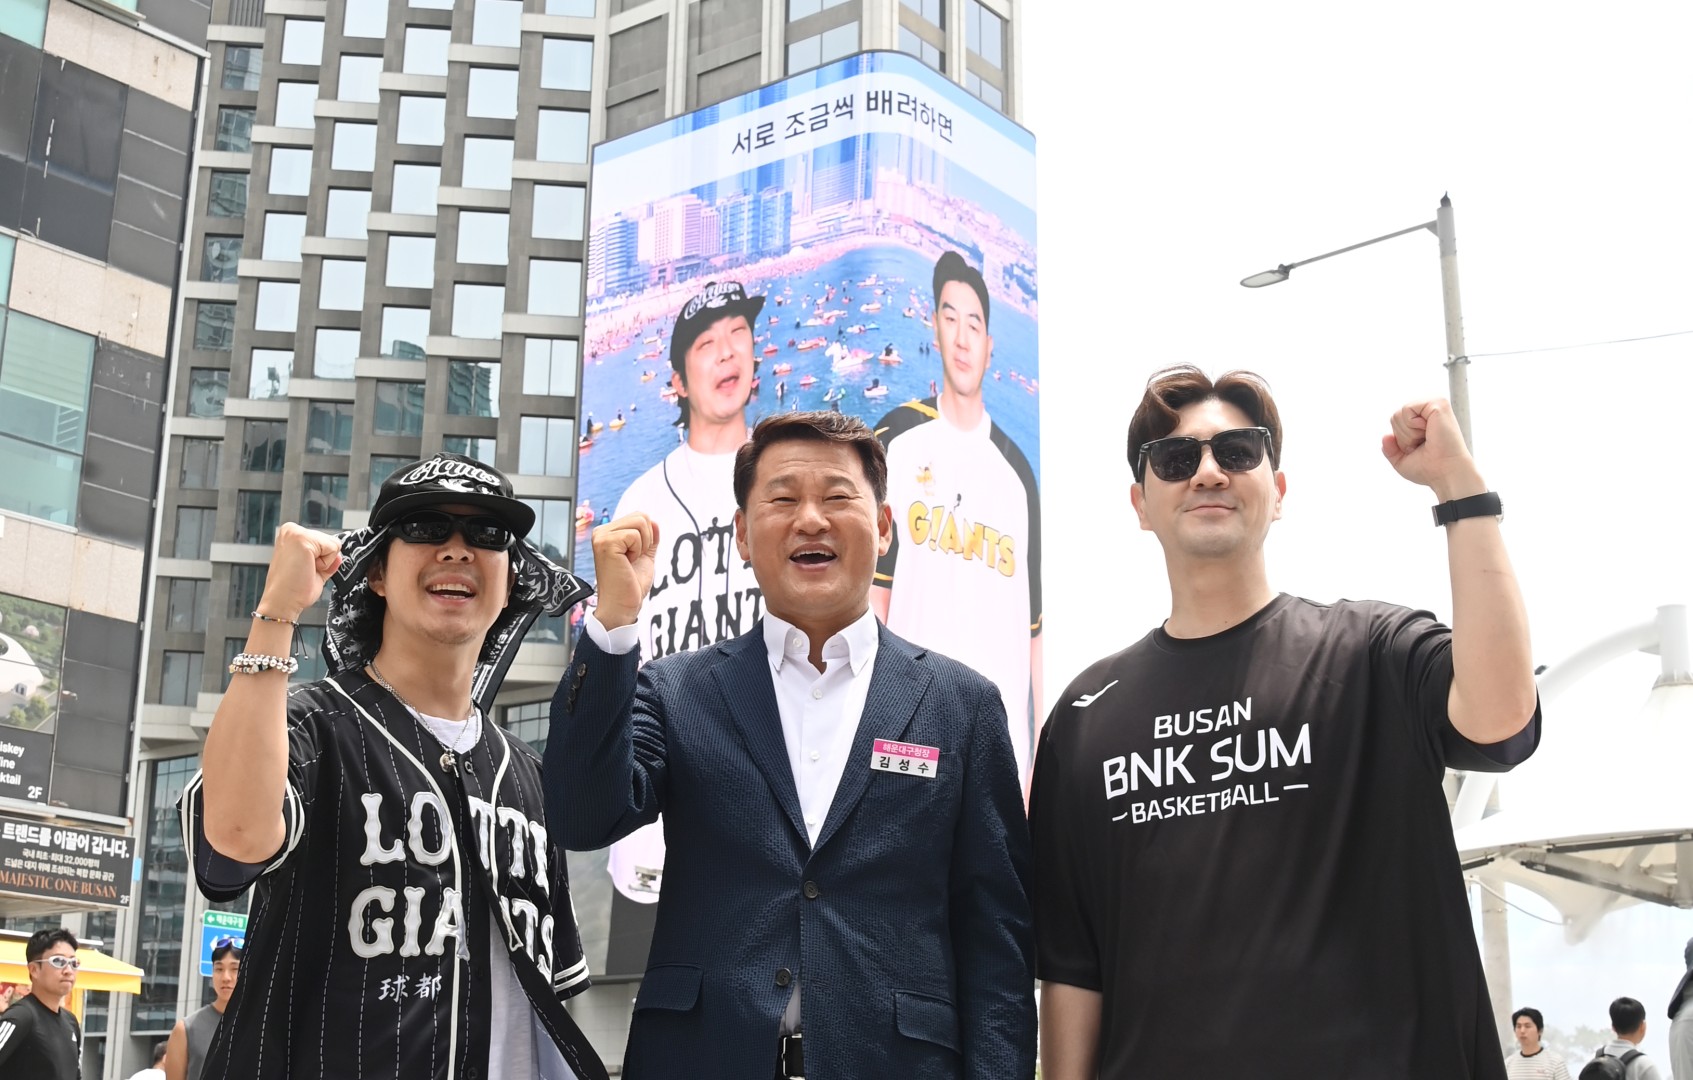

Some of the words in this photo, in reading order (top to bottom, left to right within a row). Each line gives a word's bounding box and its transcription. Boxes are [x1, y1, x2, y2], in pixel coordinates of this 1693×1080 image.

[731, 121, 775, 154] 서로
[784, 94, 854, 139] 조금씩
[866, 89, 953, 144] 배려하면
[651, 587, 764, 660] GIANT
[1154, 697, 1252, 739] BUSAN
[0, 741, 25, 757] iskey
[0, 756, 15, 769] ine
[882, 743, 930, 758] 해운대구청장
[1103, 744, 1196, 800] BNK
[1210, 723, 1311, 781] SUM
[0, 772, 21, 785] ktail
[28, 785, 43, 799] 2F
[1131, 782, 1279, 823] BASKETBALL
[22, 848, 36, 859] 국내
[54, 830, 90, 853] 이끌어
[92, 836, 130, 858] 갑니다.
[24, 860, 37, 871] 대지
[0, 870, 53, 890] MAJESTIC
[55, 878, 79, 893] ONE
[81, 881, 117, 898] BUSAN
[120, 894, 130, 904] 2F
[378, 973, 442, 1002] 球都
